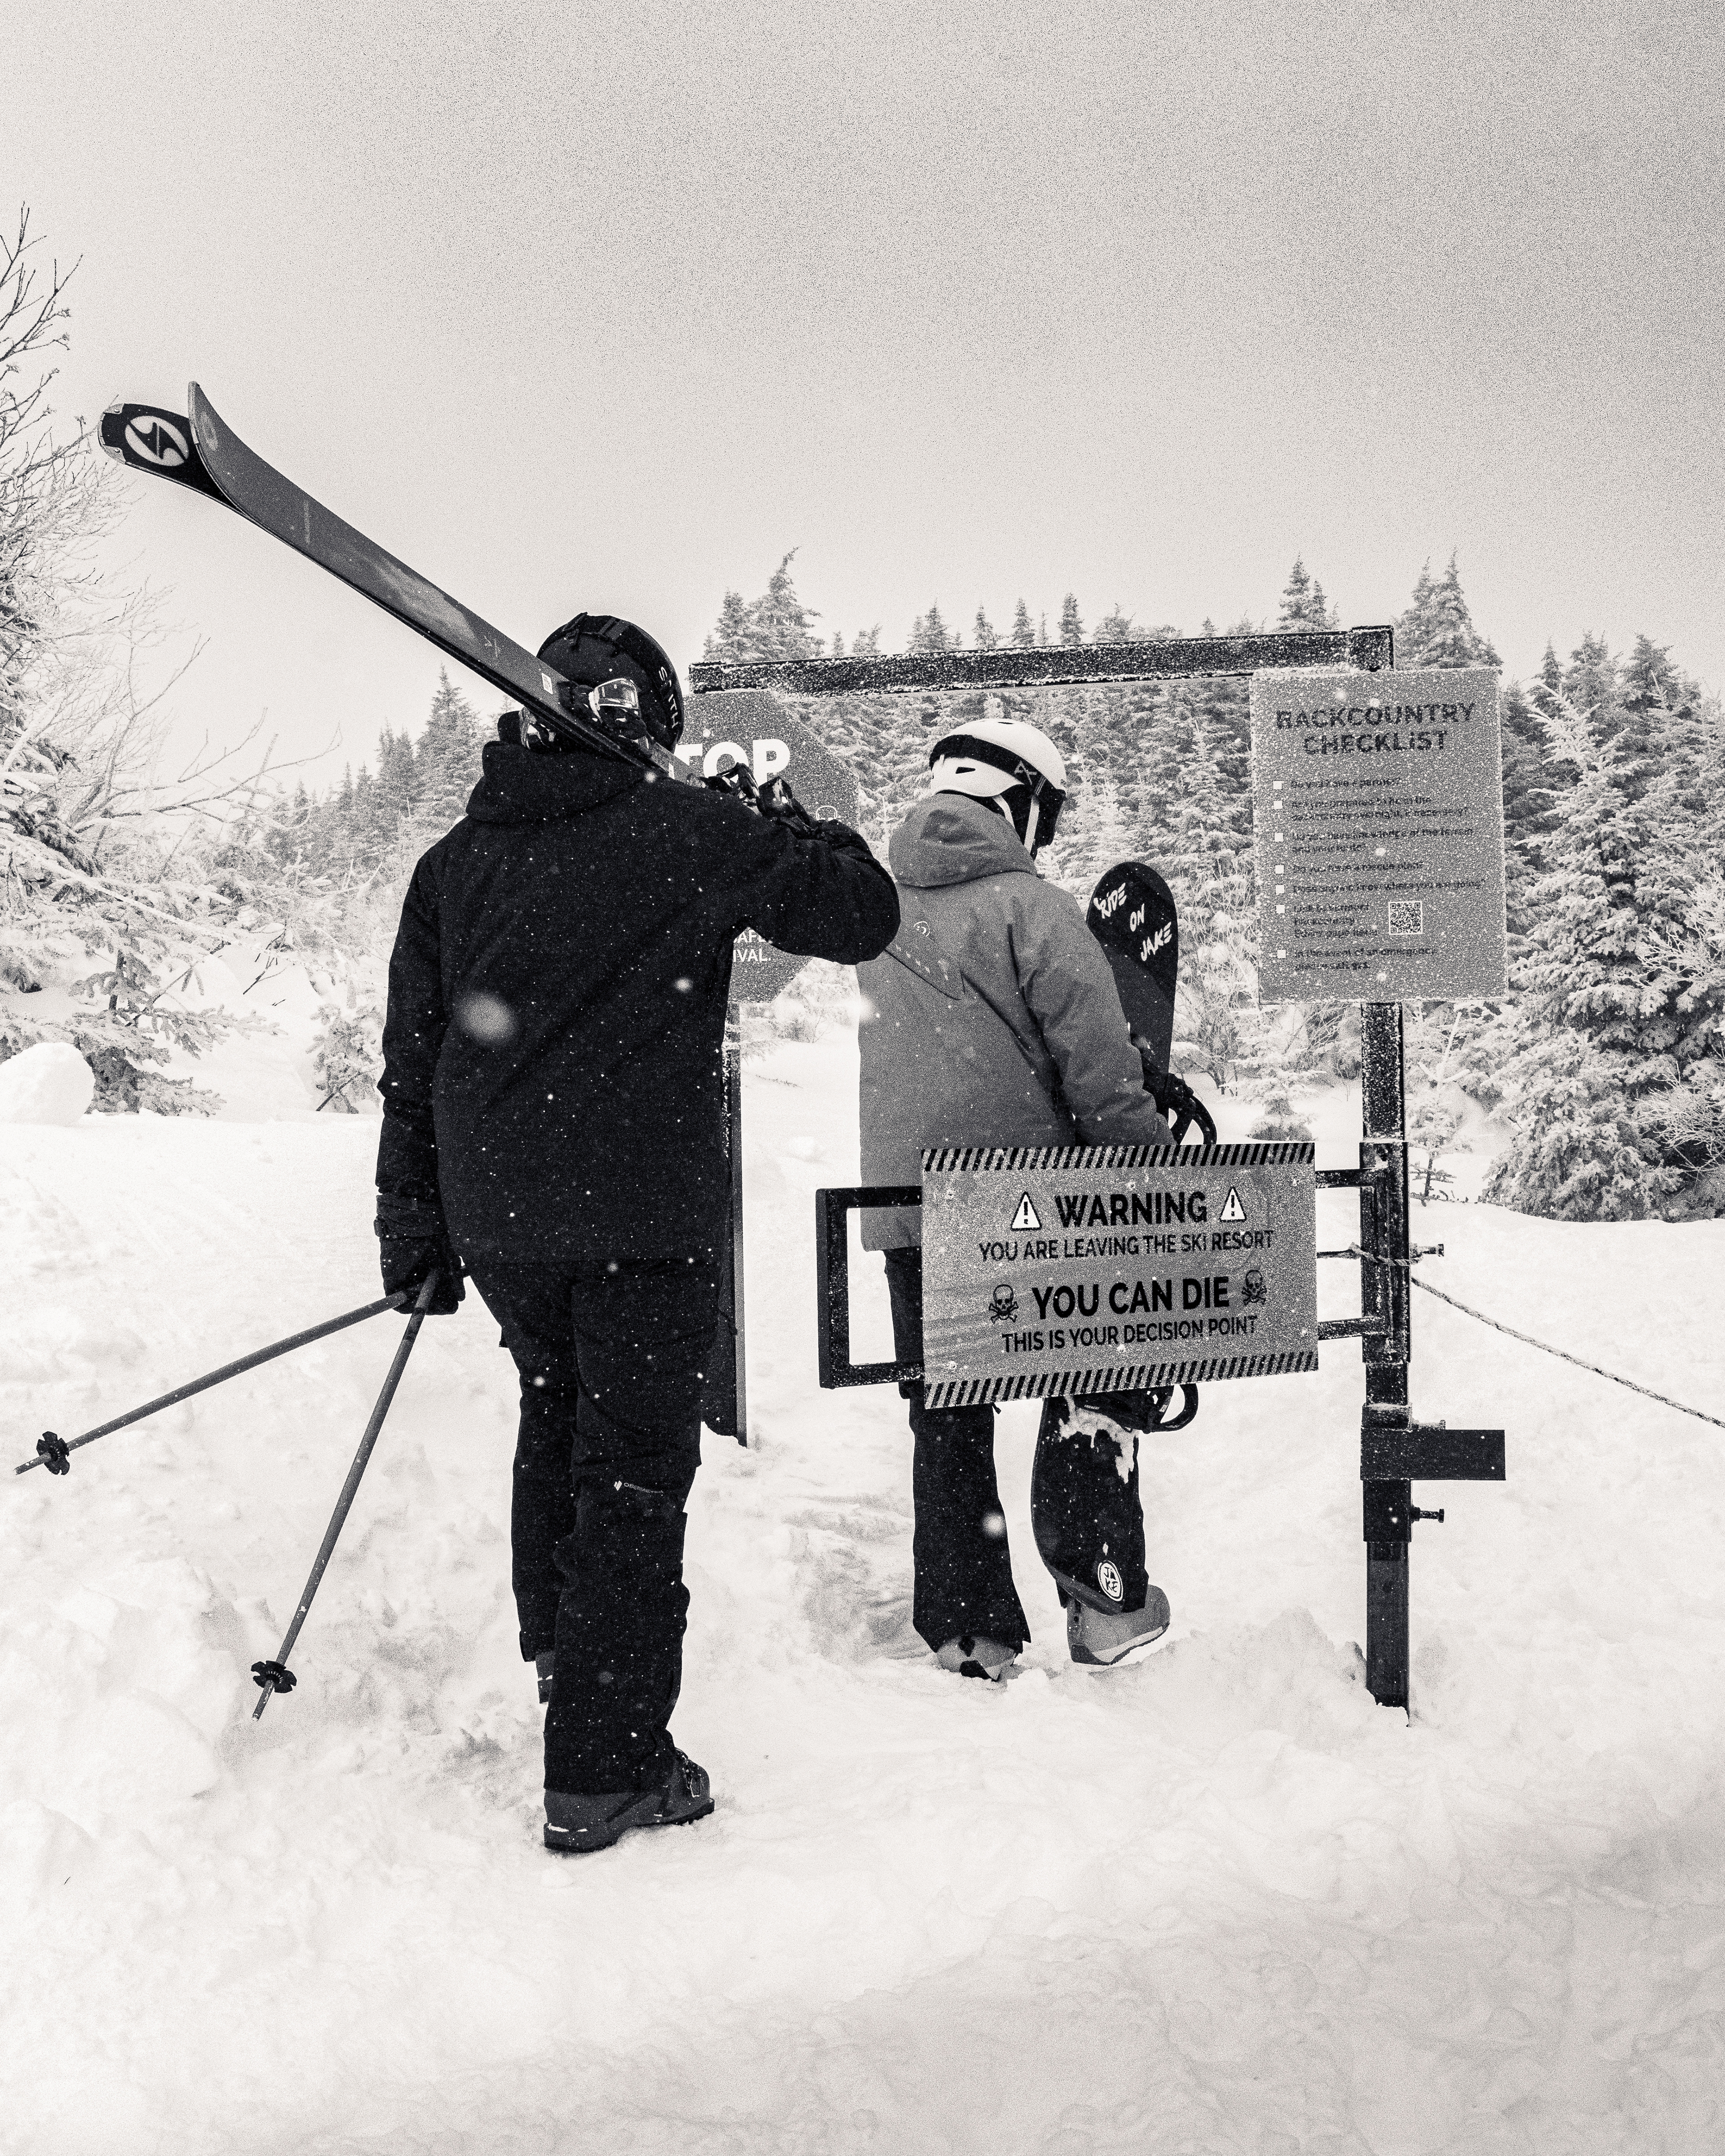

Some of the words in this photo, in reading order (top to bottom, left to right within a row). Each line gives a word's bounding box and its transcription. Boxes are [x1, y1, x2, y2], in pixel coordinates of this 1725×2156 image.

[1276, 702, 1474, 729] BACKCOUNTRY
[1304, 731, 1447, 755] CHECKLIST
[674, 739, 790, 786] TOP
[1130, 903, 1145, 932] ON
[1141, 922, 1172, 961] JAKE
[1055, 1191, 1207, 1228] WARNING
[979, 1241, 1018, 1261] YOU
[1024, 1240, 1058, 1259] ARE
[1064, 1236, 1139, 1258] LEAVING
[1143, 1235, 1176, 1254] THE
[1181, 1233, 1207, 1252] SKI
[1212, 1230, 1274, 1251] RESORT
[1031, 1283, 1099, 1320] YOU
[1109, 1280, 1172, 1314] CAN
[1182, 1276, 1230, 1309] DIE
[1002, 1331, 1044, 1353] THIS
[1049, 1330, 1065, 1349] IS
[1069, 1325, 1119, 1347] YOUR
[1124, 1320, 1203, 1343] DECISION
[1208, 1315, 1258, 1337] POINT
